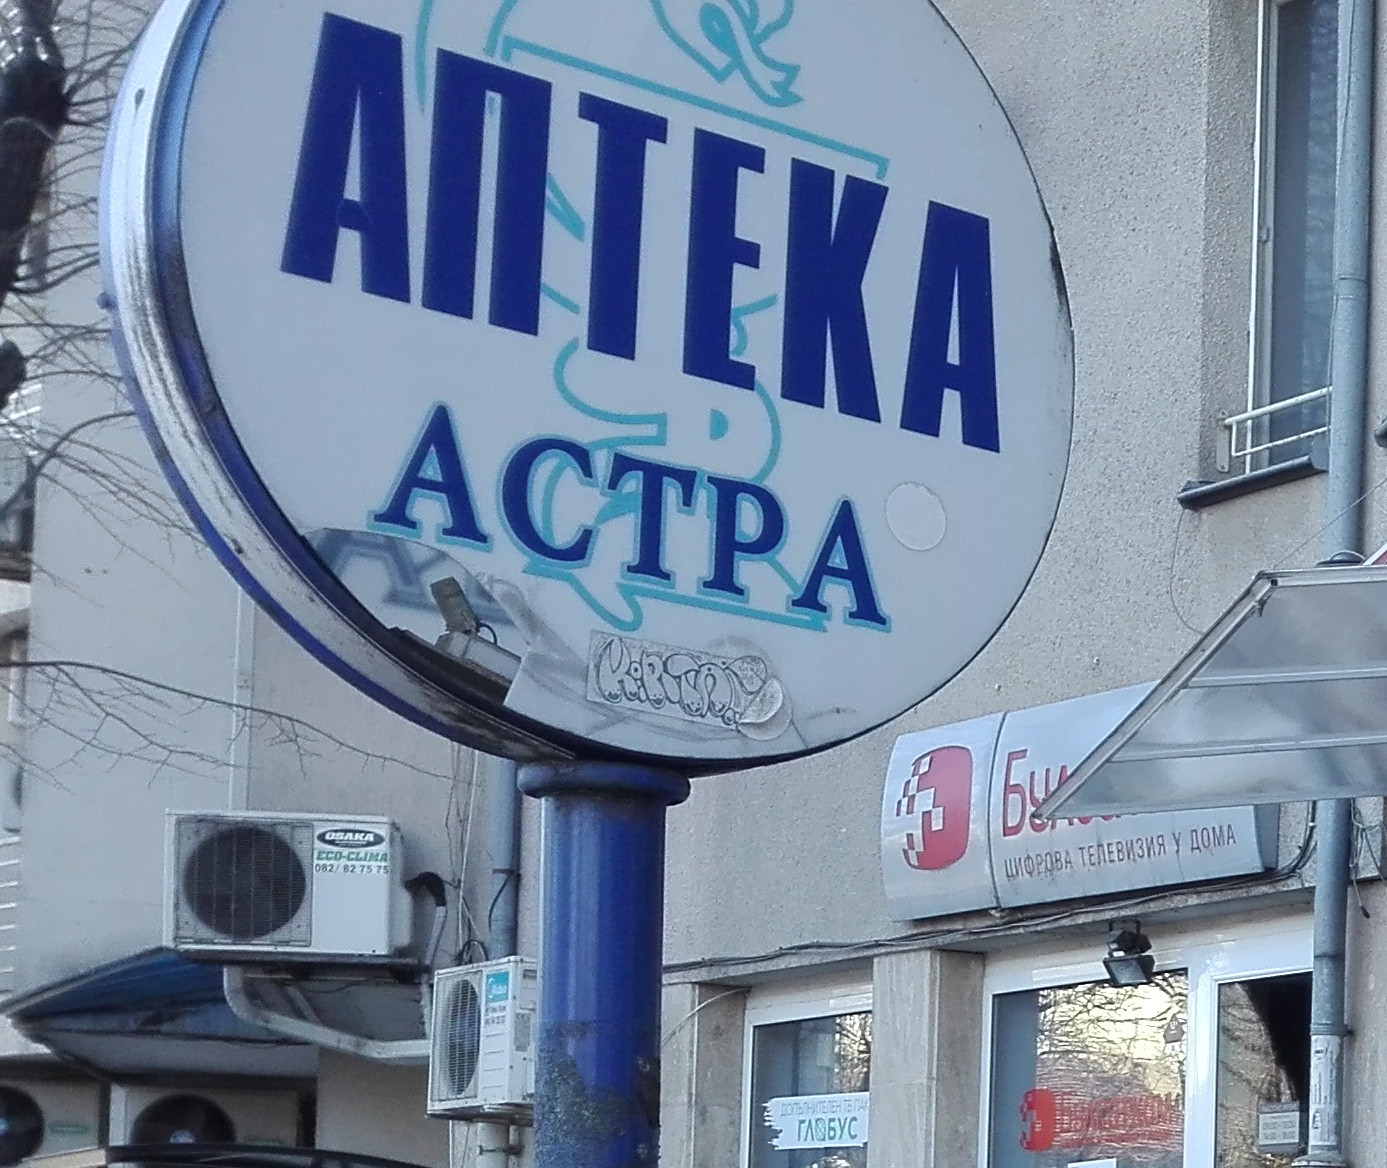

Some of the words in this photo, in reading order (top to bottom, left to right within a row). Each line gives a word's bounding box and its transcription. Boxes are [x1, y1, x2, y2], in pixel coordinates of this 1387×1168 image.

[279, 12, 1001, 454] АПТЕКА
[370, 402, 891, 630] АСТРА
[316, 850, 389, 863] ECO-CLIMA
[324, 831, 375, 842] OSAKA
[1003, 847, 1074, 880] ЦИФРОВА
[1078, 834, 1166, 868] ТЕЛЕВИЗИЯ
[1173, 834, 1183, 854] У
[1189, 822, 1237, 855] ДОМА
[797, 1115, 859, 1142] ГЛОБУС
